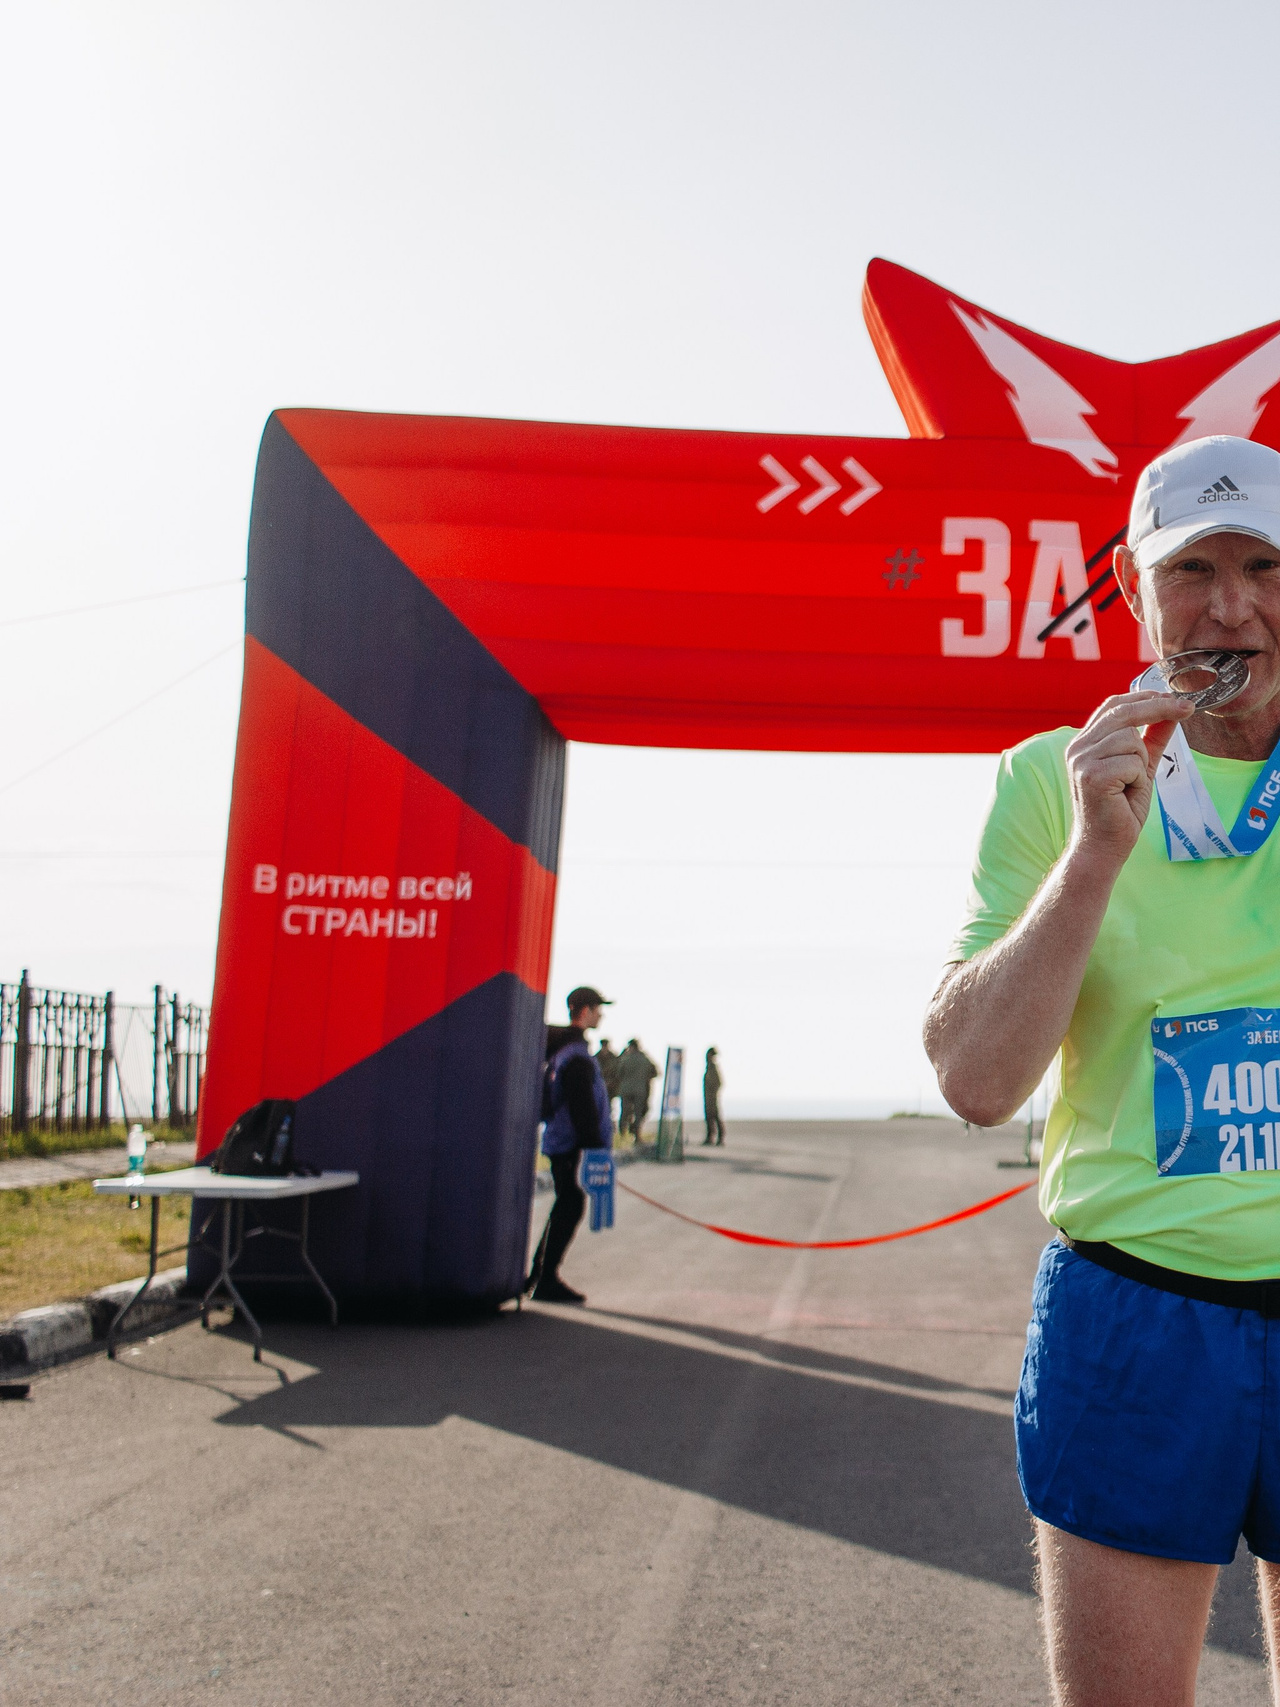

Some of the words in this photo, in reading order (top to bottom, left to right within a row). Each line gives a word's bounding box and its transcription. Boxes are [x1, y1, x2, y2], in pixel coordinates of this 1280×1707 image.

[1197, 491, 1249, 504] adidas
[254, 863, 278, 894] В
[285, 872, 390, 899] ритме
[398, 871, 474, 900] всей
[281, 904, 438, 938] СТРАНЫ!
[1185, 1018, 1219, 1033] ПСБ
